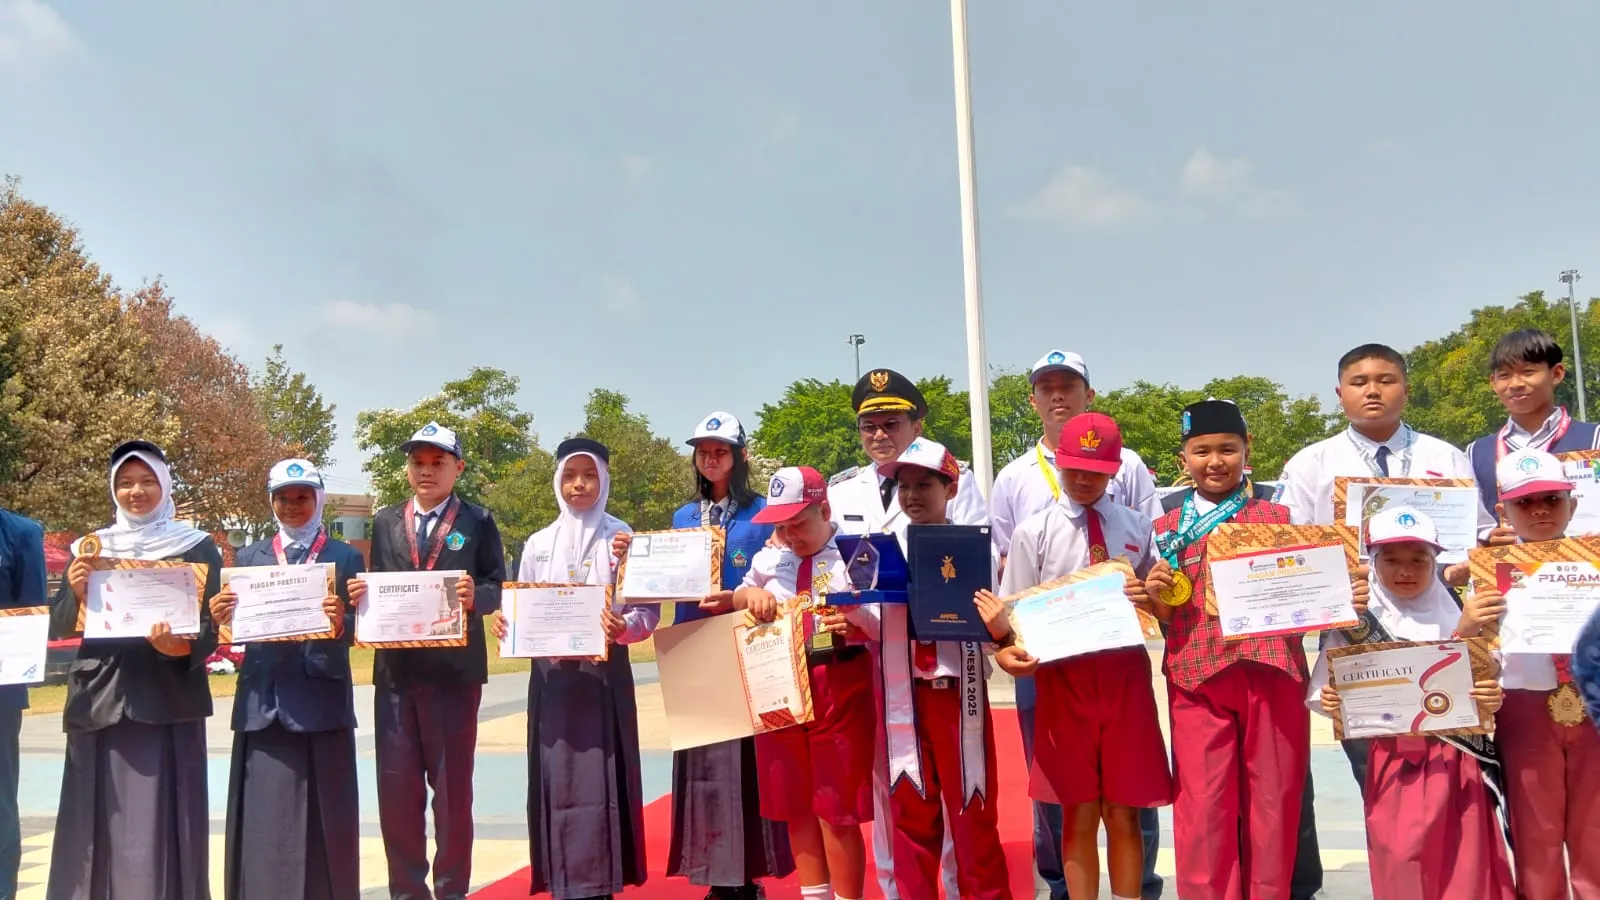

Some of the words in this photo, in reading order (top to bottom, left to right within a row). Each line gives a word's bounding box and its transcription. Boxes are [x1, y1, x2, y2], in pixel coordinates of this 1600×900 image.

[250, 581, 275, 590] PIAGAM
[1538, 574, 1600, 583] PIAGAM
[379, 584, 420, 594] CERTIFICATE
[745, 636, 785, 655] CERTIFICATE
[966, 640, 976, 684] ONESIA
[1342, 666, 1415, 682] CERTIFICATE
[967, 687, 977, 716] 2025
